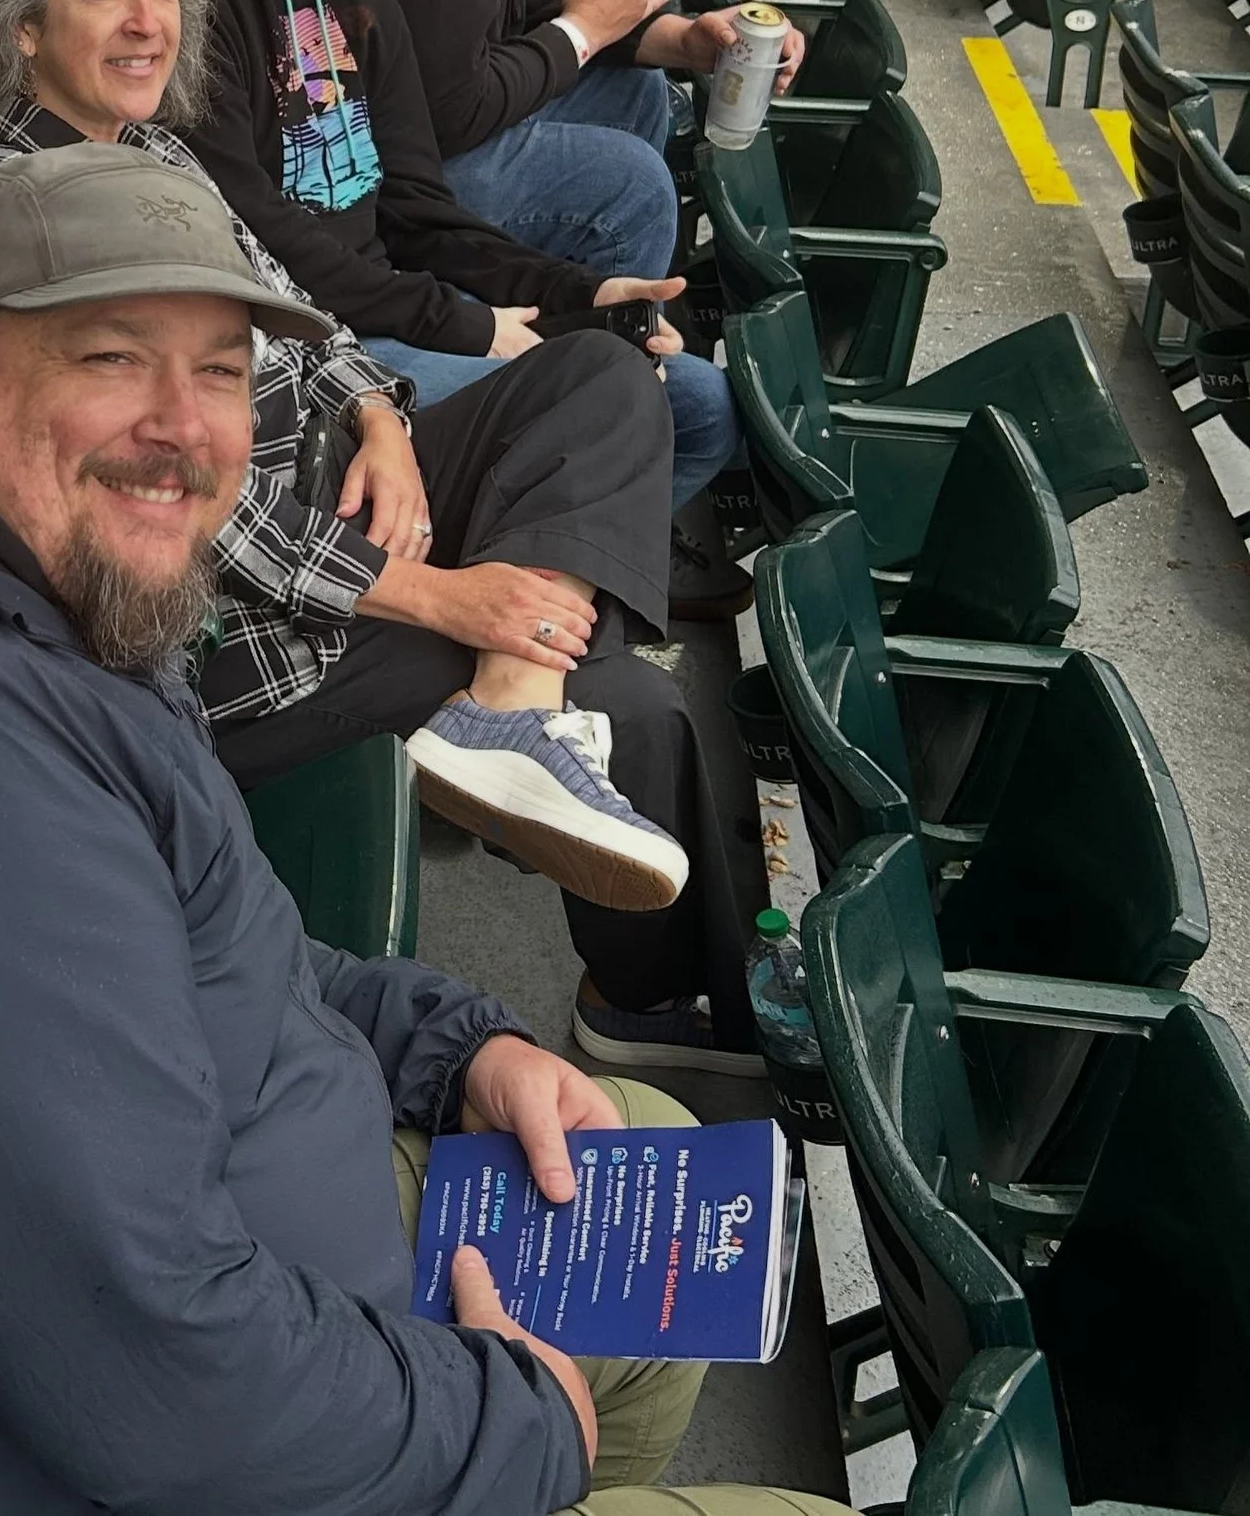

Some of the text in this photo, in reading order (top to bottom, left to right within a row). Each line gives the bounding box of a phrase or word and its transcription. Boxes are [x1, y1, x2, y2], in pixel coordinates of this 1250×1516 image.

[1131, 236, 1179, 254] ULTRA
[1201, 372, 1244, 388] LTRA
[490, 1172, 507, 1234] Call Today
[578, 1166, 596, 1261] Guaranteed Comfort
[602, 1199, 612, 1223] Pricing
[614, 1165, 626, 1225] No Surprises
[639, 1164, 657, 1264] Fast, Reliable Service
[538, 1211, 554, 1266] Specializing
[600, 1230, 608, 1248] Clear
[631, 1214, 641, 1246] Windows
[659, 1149, 689, 1333] No Surprises. Just Solutions.
[708, 1195, 752, 1272] Pacific
